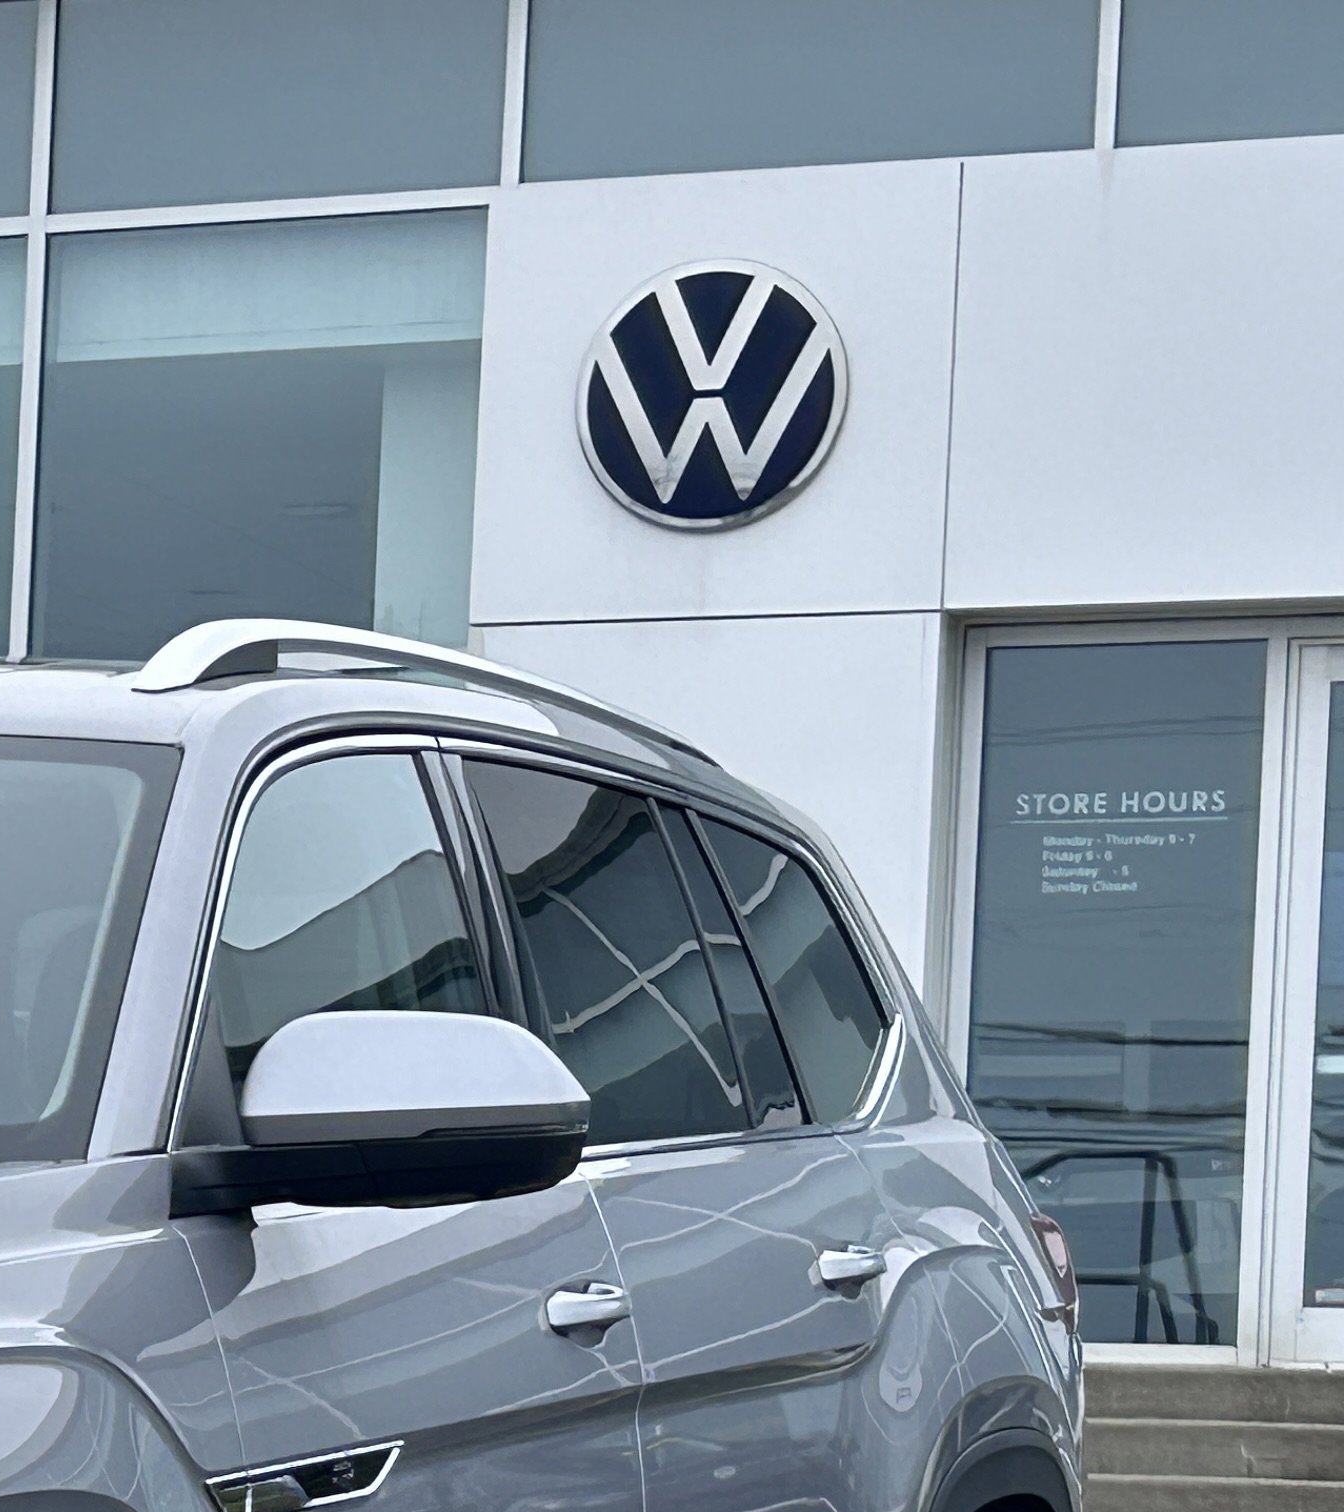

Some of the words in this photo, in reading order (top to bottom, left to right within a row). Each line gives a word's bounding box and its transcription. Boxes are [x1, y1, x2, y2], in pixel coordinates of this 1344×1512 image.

[584, 262, 838, 508] VW
[1015, 792, 1108, 816] STORE
[1120, 789, 1227, 814] HOURS
[1105, 833, 1165, 847] Thursday
